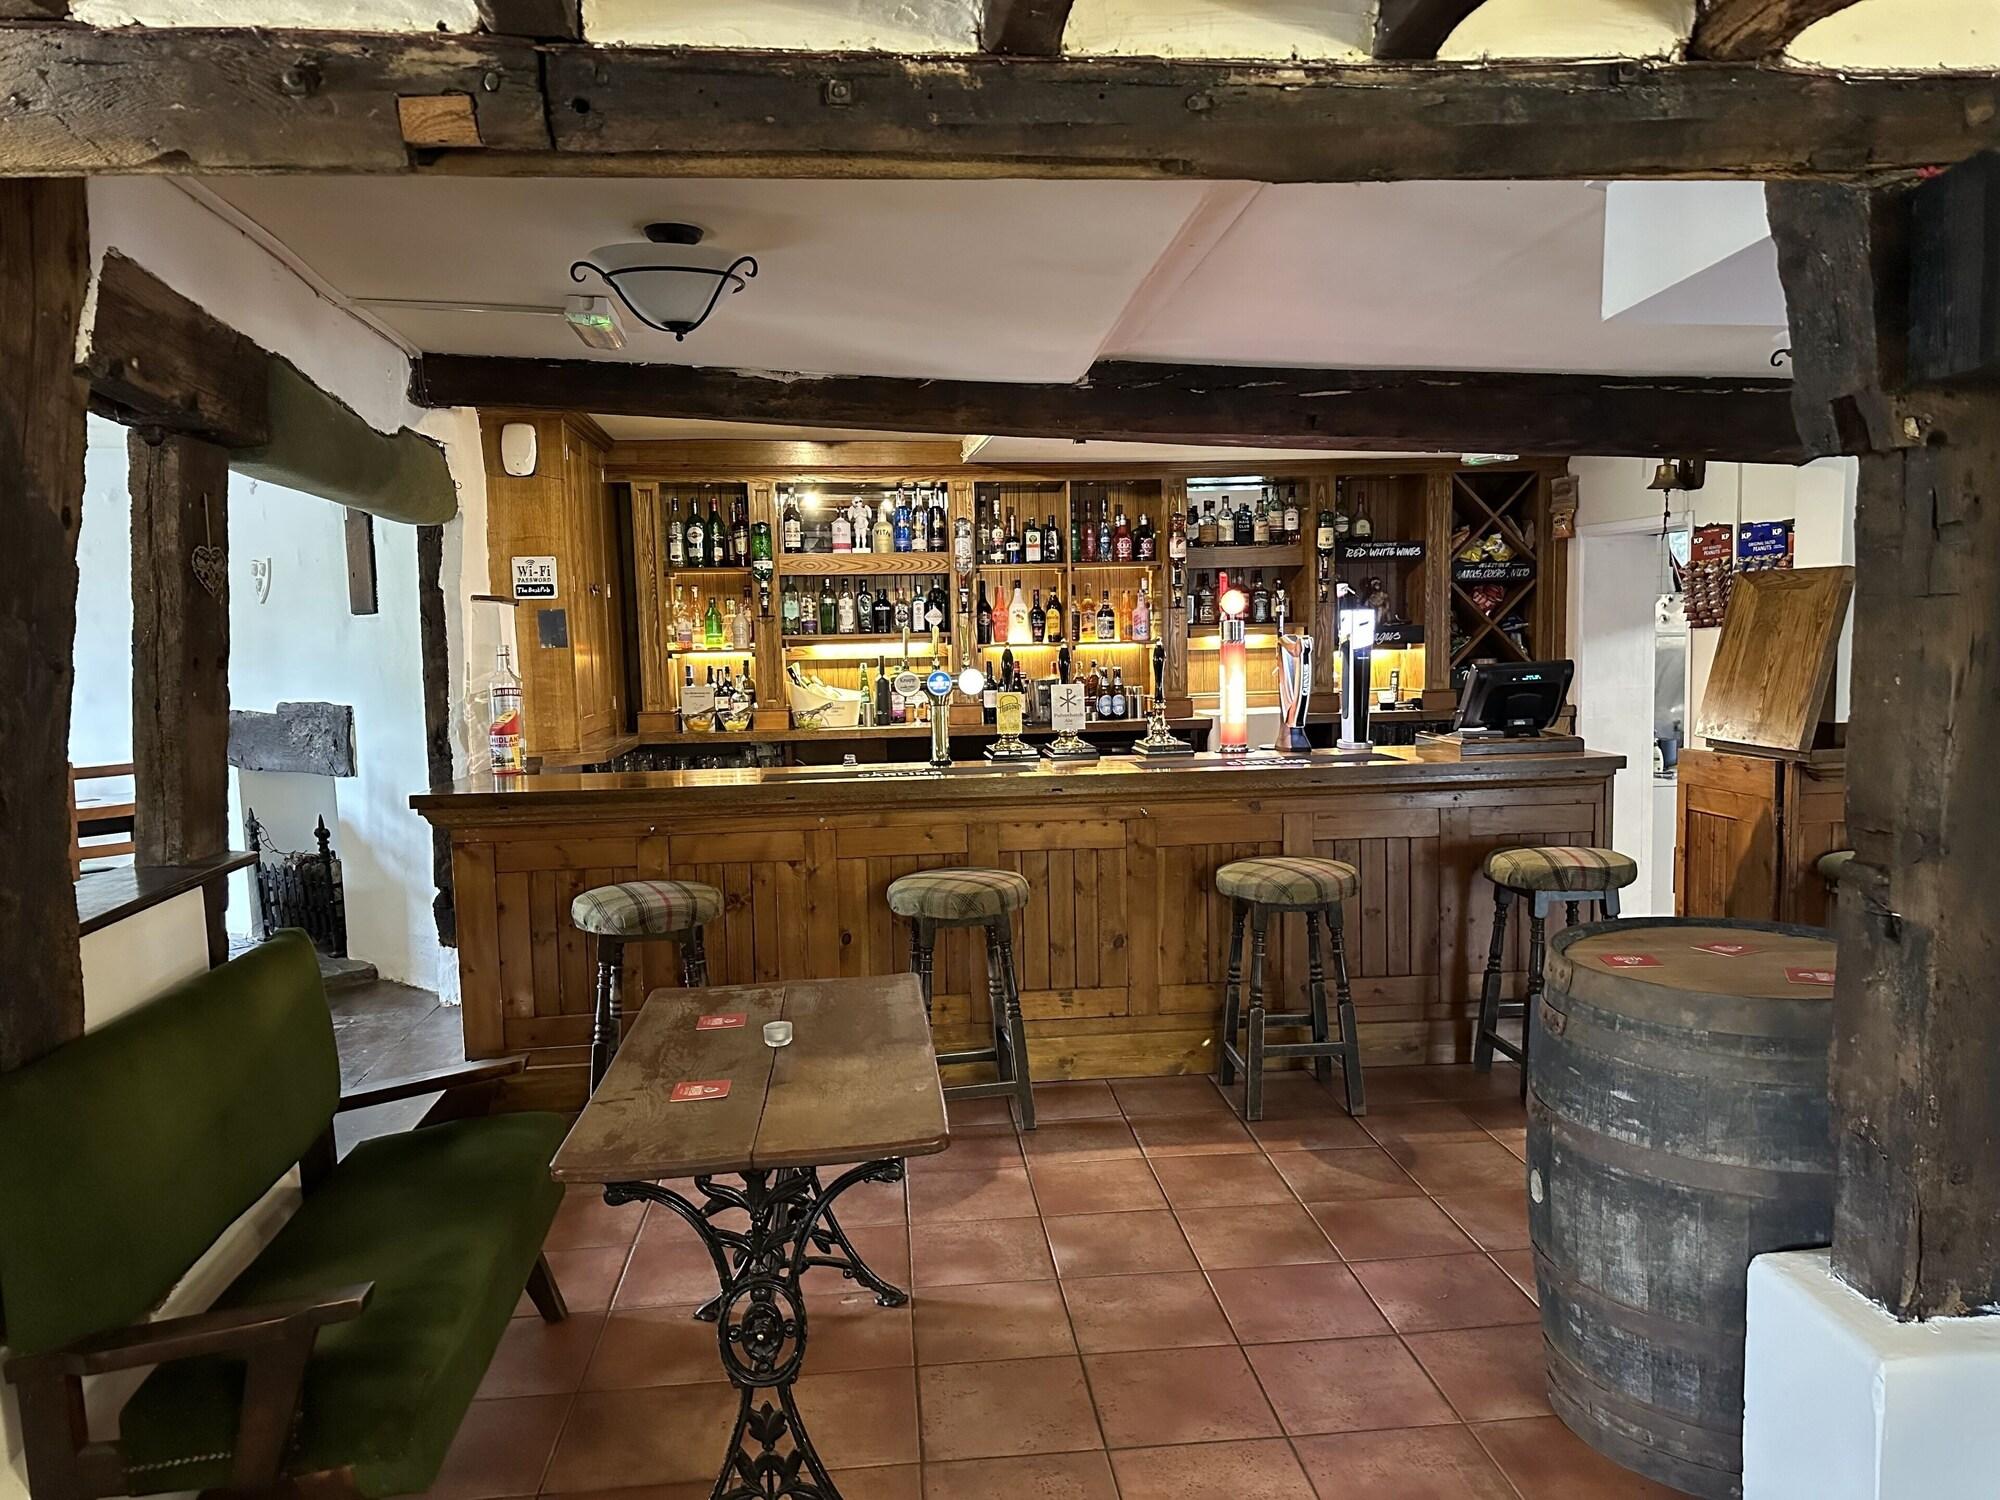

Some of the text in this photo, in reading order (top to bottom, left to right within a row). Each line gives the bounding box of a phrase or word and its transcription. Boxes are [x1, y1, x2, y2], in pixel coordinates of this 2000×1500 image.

[1773, 528, 1783, 536] KP
[1345, 546, 1421, 558] RED WHITE WINES
[517, 565, 551, 576] Wi-Fi
